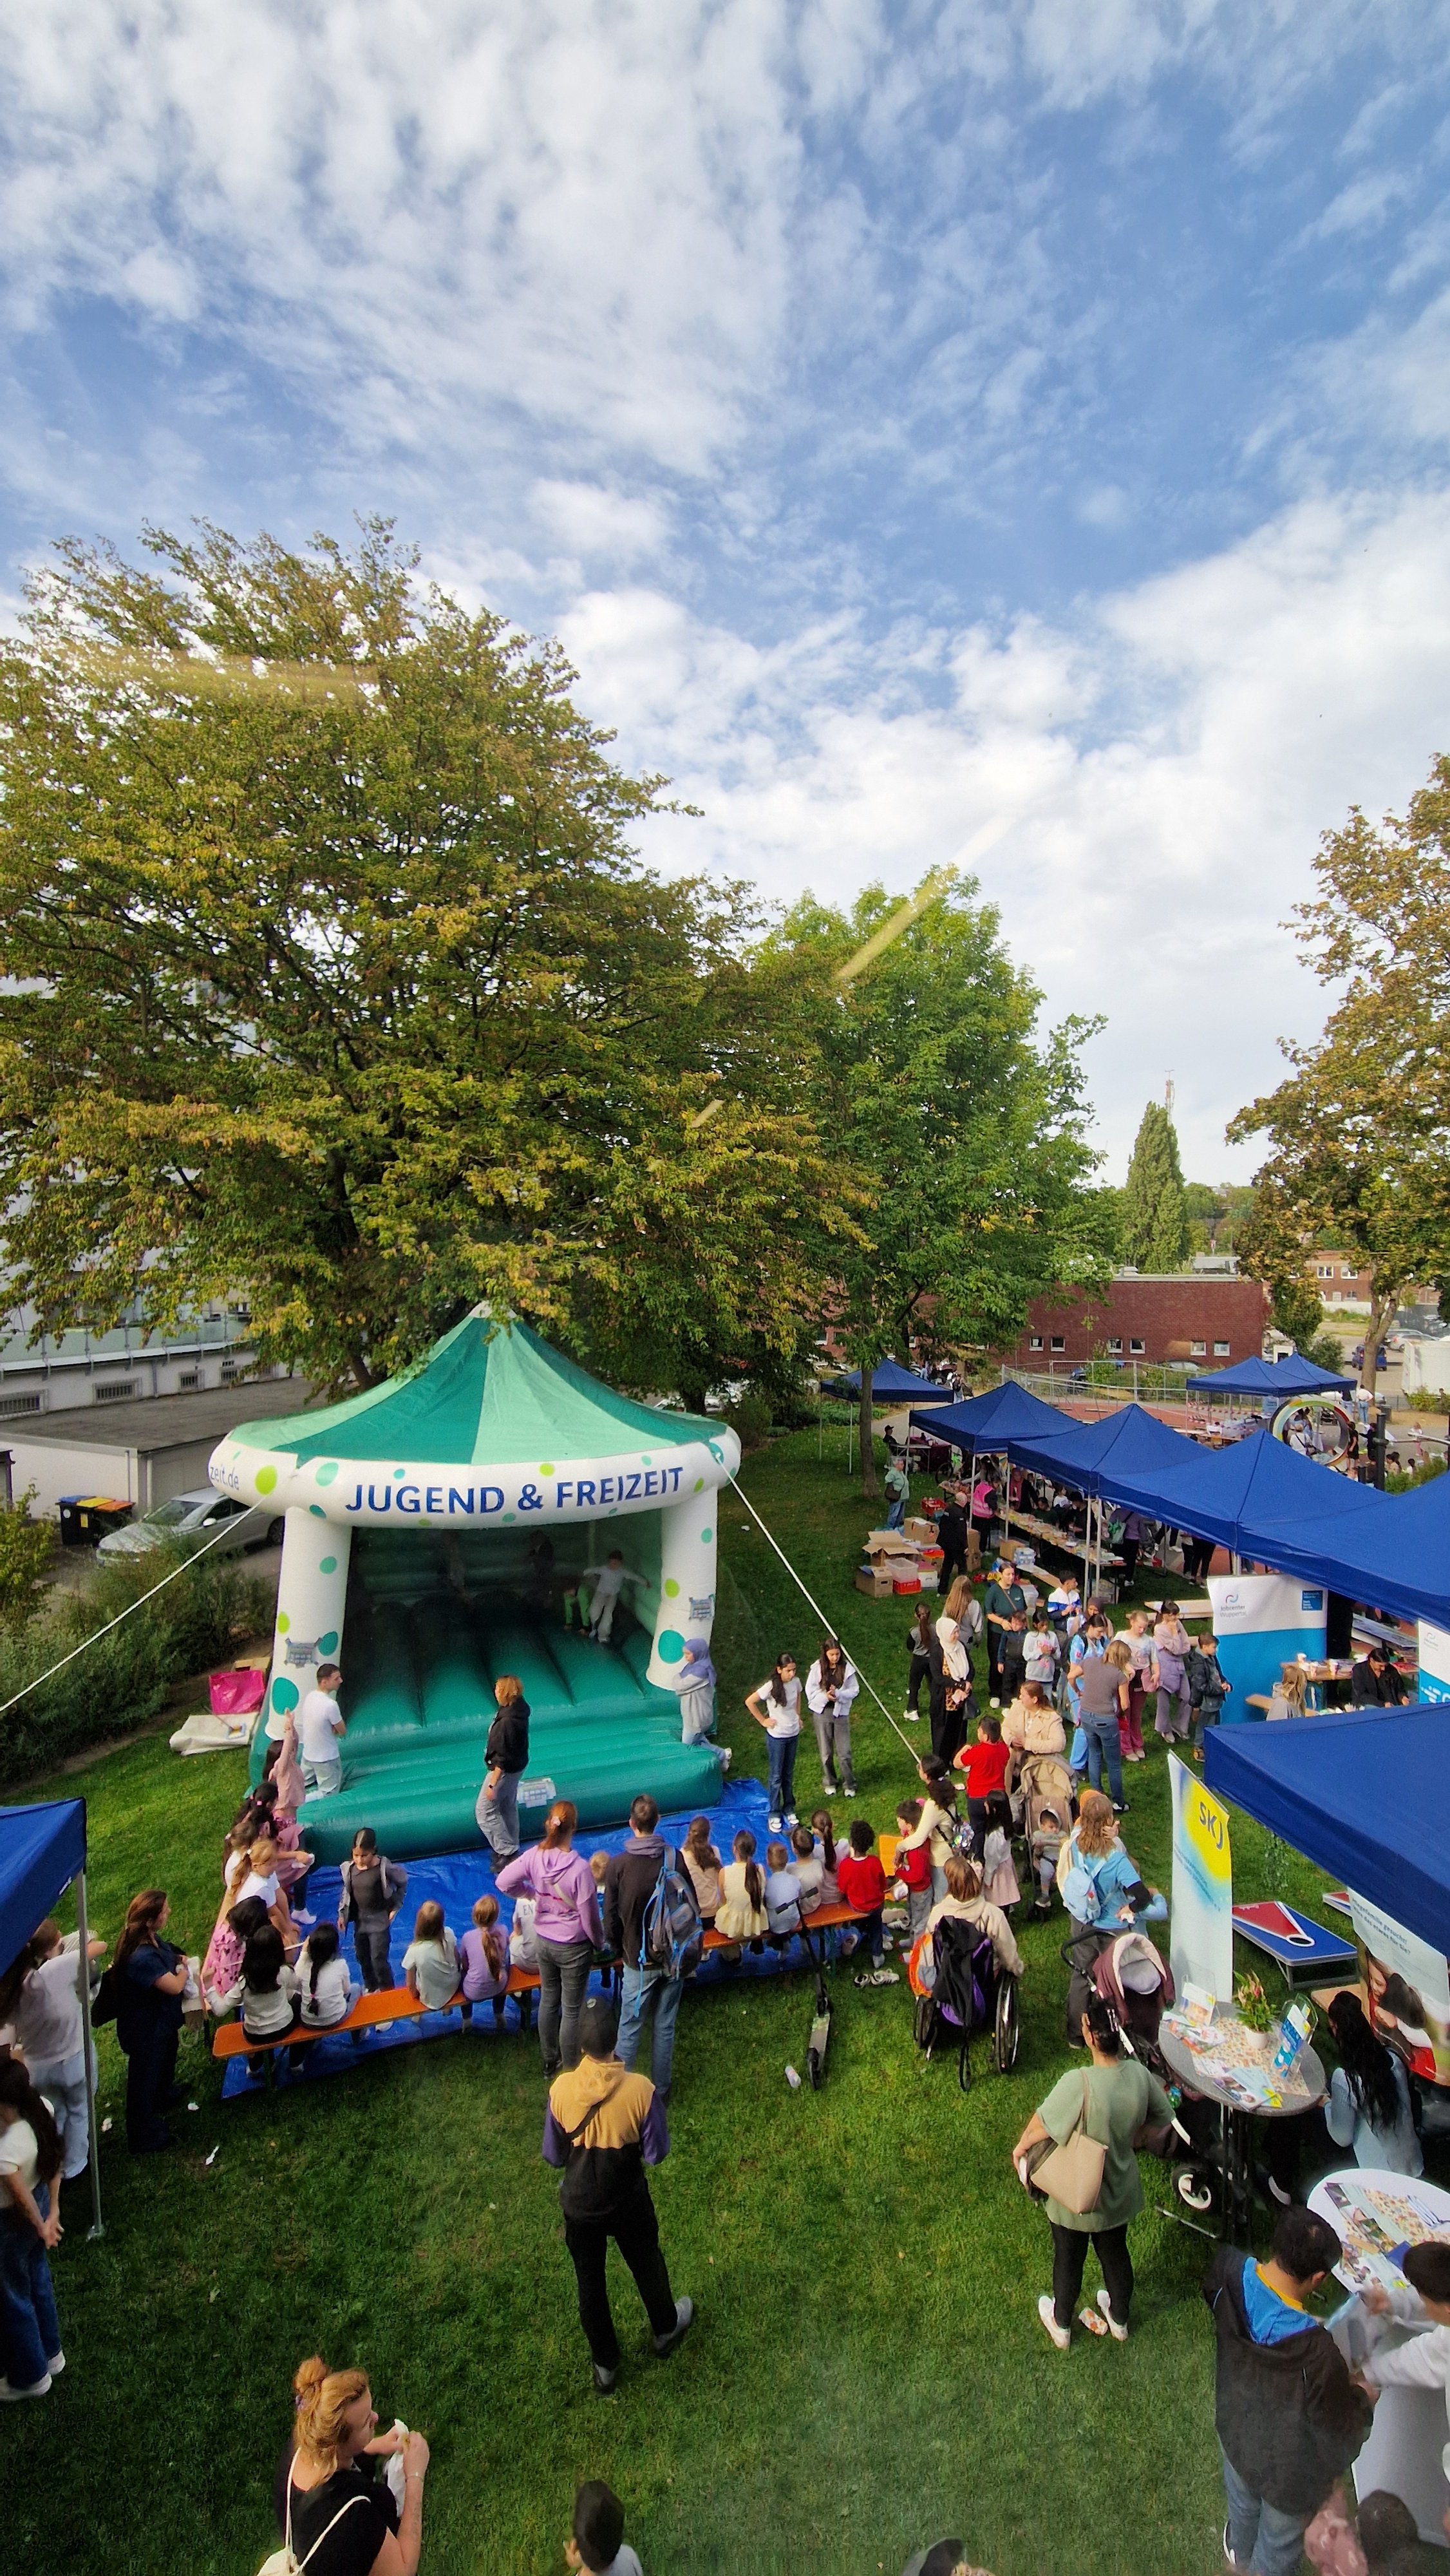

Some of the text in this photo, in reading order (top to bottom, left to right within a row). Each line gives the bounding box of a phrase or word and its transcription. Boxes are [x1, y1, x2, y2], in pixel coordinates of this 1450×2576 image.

[345, 1466, 684, 1515] JUGEND & FREIZEIT
[1199, 1801, 1223, 1850] SKJ
